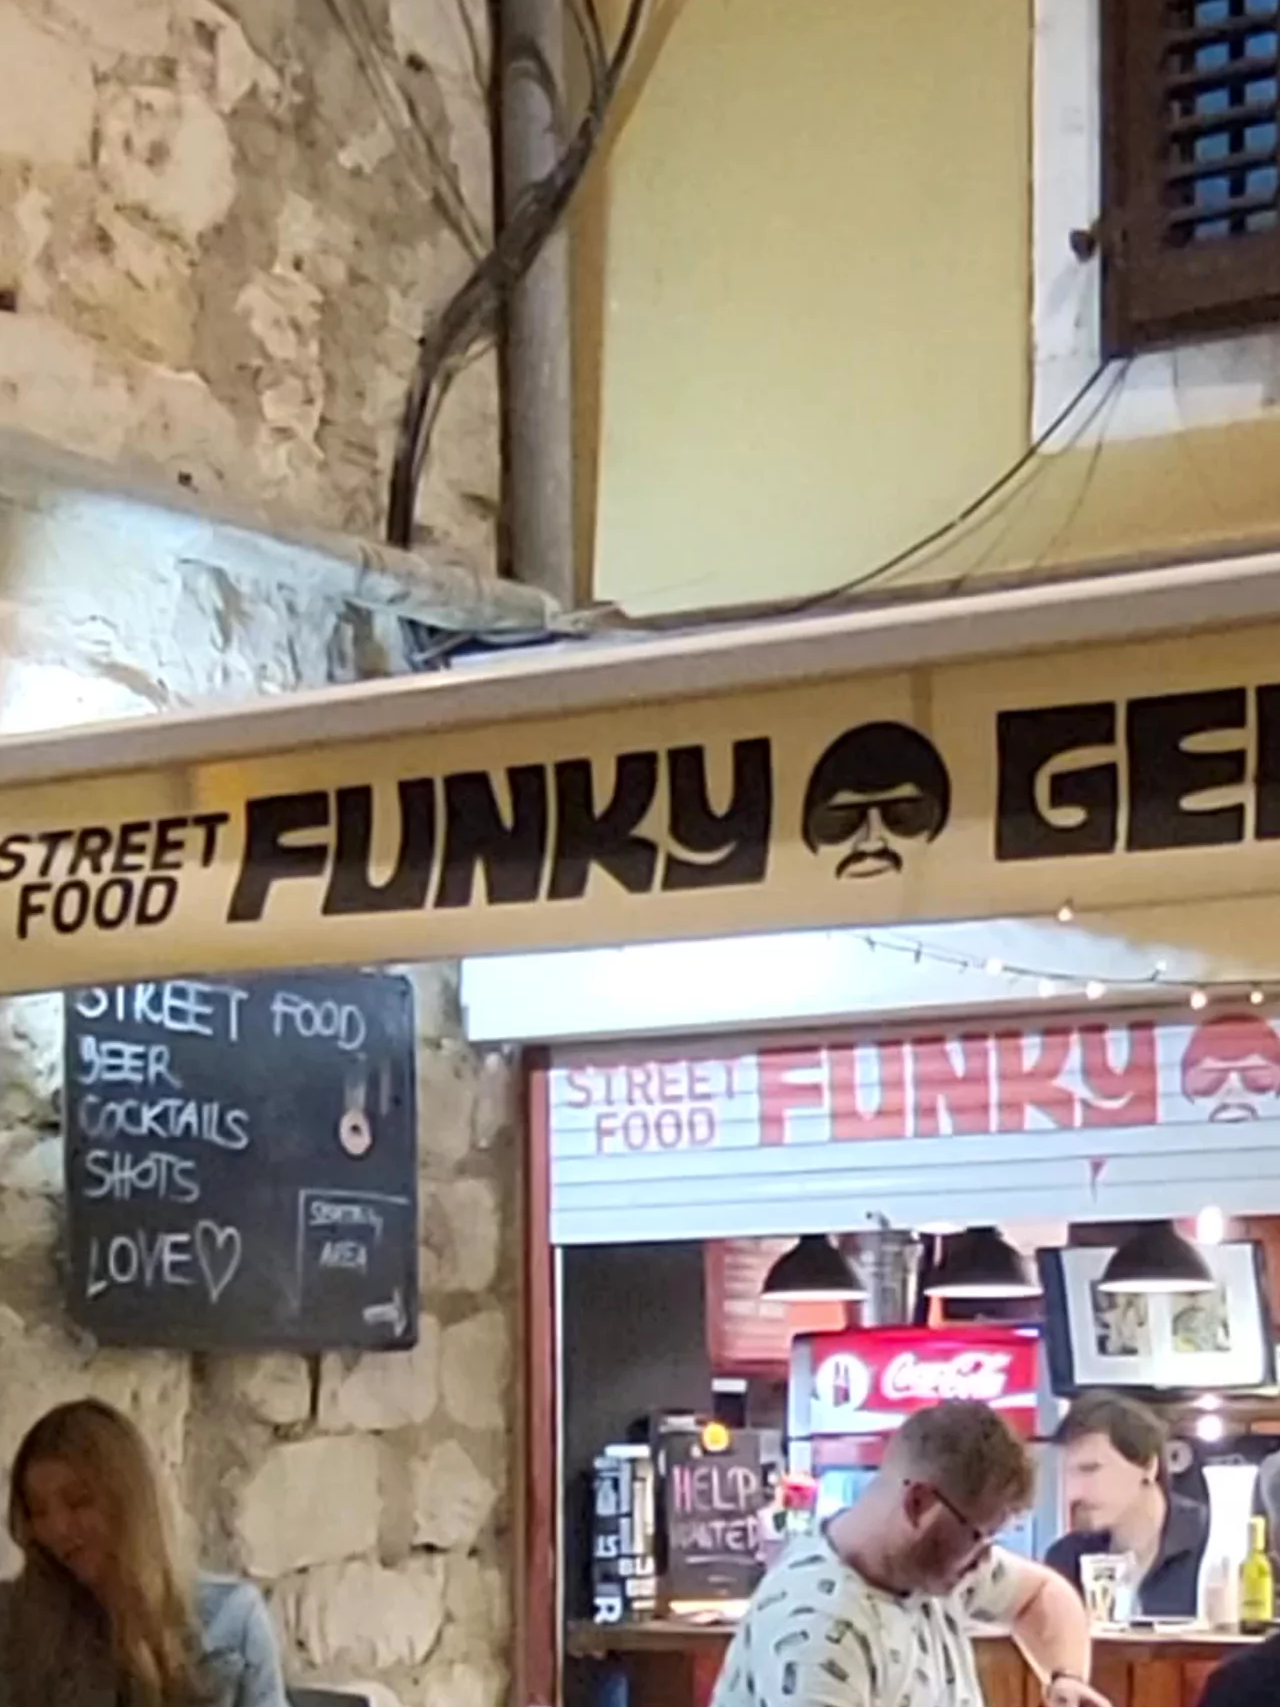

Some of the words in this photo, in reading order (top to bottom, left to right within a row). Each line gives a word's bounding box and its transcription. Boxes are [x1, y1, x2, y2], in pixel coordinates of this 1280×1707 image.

[227, 736, 773, 923] FUNKY
[16, 875, 178, 939] FOOD
[75, 981, 248, 1041] STREET
[271, 991, 366, 1051] FOOD
[78, 1036, 181, 1088] BEER
[565, 1056, 743, 1111] STREET
[757, 1021, 1158, 1146] FUNKY
[79, 1093, 250, 1150] COCKTAILS
[595, 1106, 717, 1152] FOOD
[84, 1150, 200, 1203] SHOTS
[87, 1230, 195, 1298] LOVE
[671, 1464, 758, 1514] HELP
